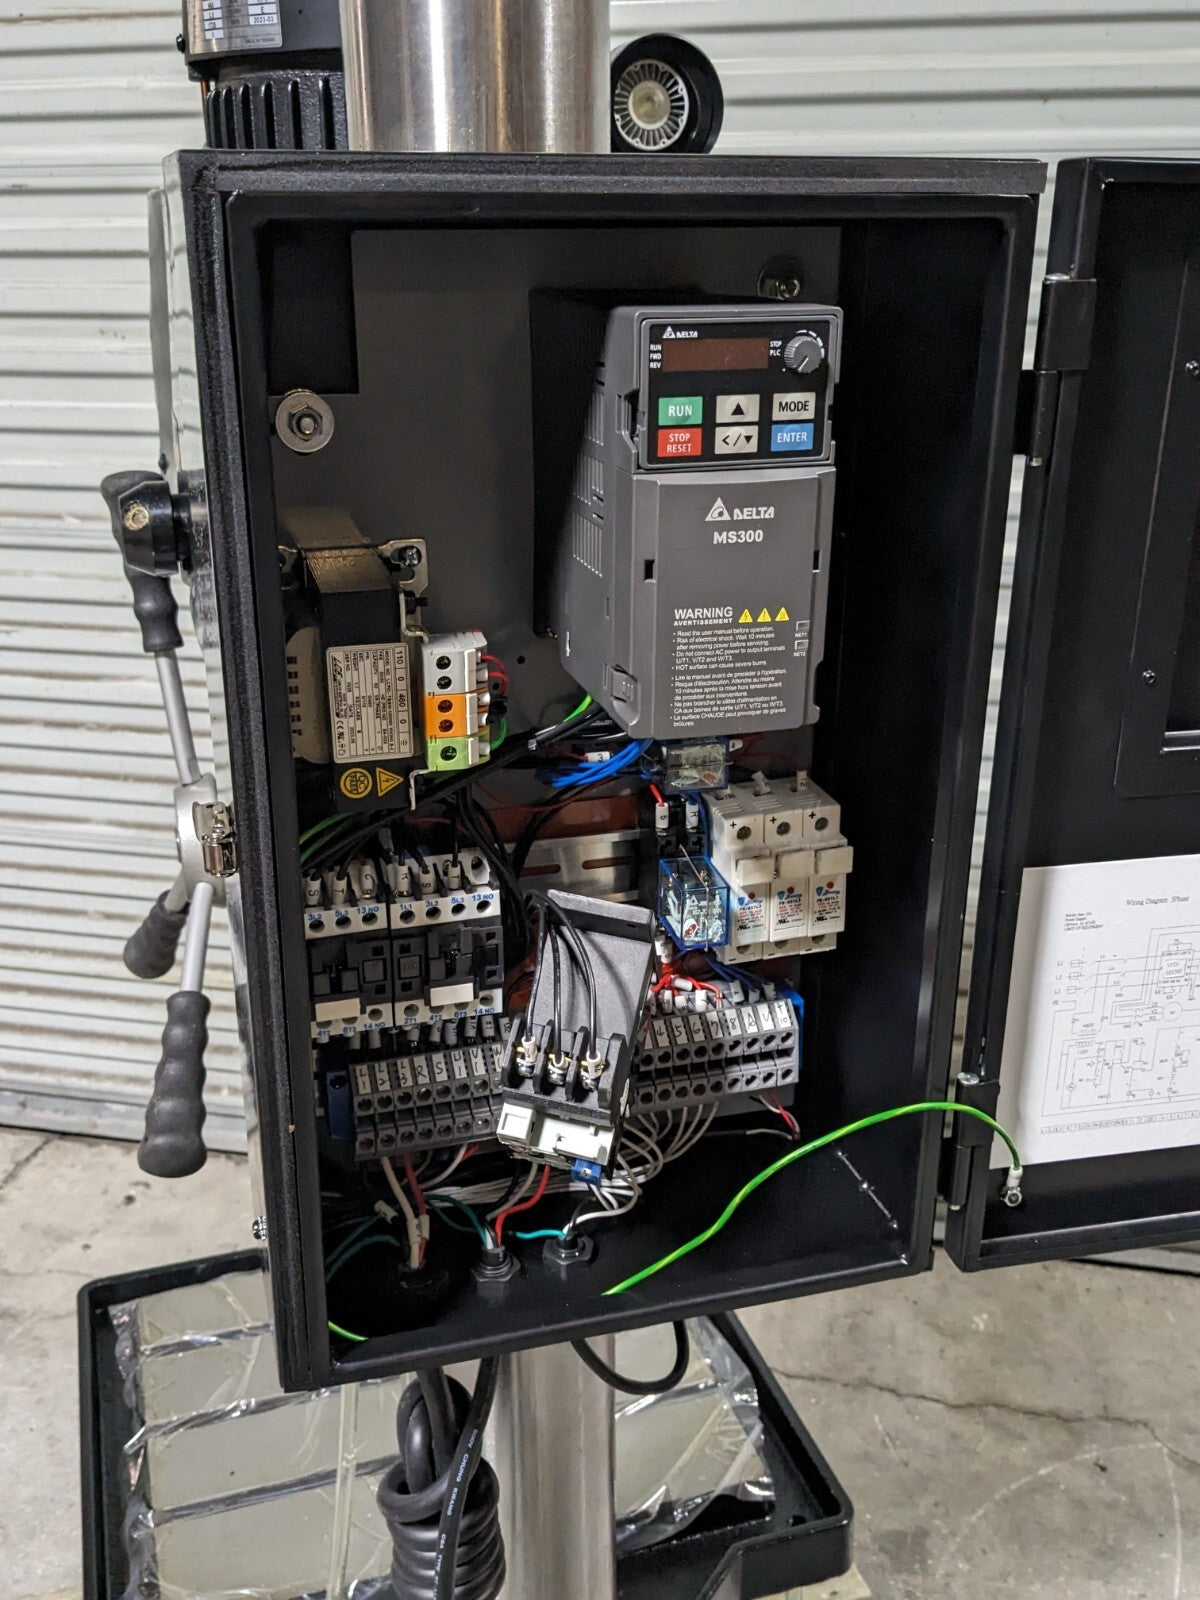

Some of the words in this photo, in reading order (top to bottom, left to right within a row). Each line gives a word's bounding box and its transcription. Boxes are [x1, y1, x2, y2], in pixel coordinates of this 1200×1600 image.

[770, 340, 782, 348] STOP
[668, 404, 692, 417] RUN
[778, 401, 810, 412] MODE
[669, 433, 690, 442] STOP
[777, 432, 808, 443] ENTER
[667, 443, 691, 453] RESET
[733, 506, 775, 520] DELTA
[713, 529, 764, 544] MS300
[674, 607, 733, 620] WARNING
[673, 618, 733, 626] AVERTISSEMENT
[737, 709, 761, 717] provoquer
[692, 1022, 700, 1034] 6
[710, 1021, 719, 1035] 7
[730, 1018, 737, 1030] 8
[656, 1026, 665, 1036] 4
[674, 1026, 682, 1038] 5
[416, 1065, 427, 1078] R
[436, 1062, 444, 1074] S
[456, 1454, 469, 1482] CHUNG
[447, 1488, 458, 1516] KWANG
